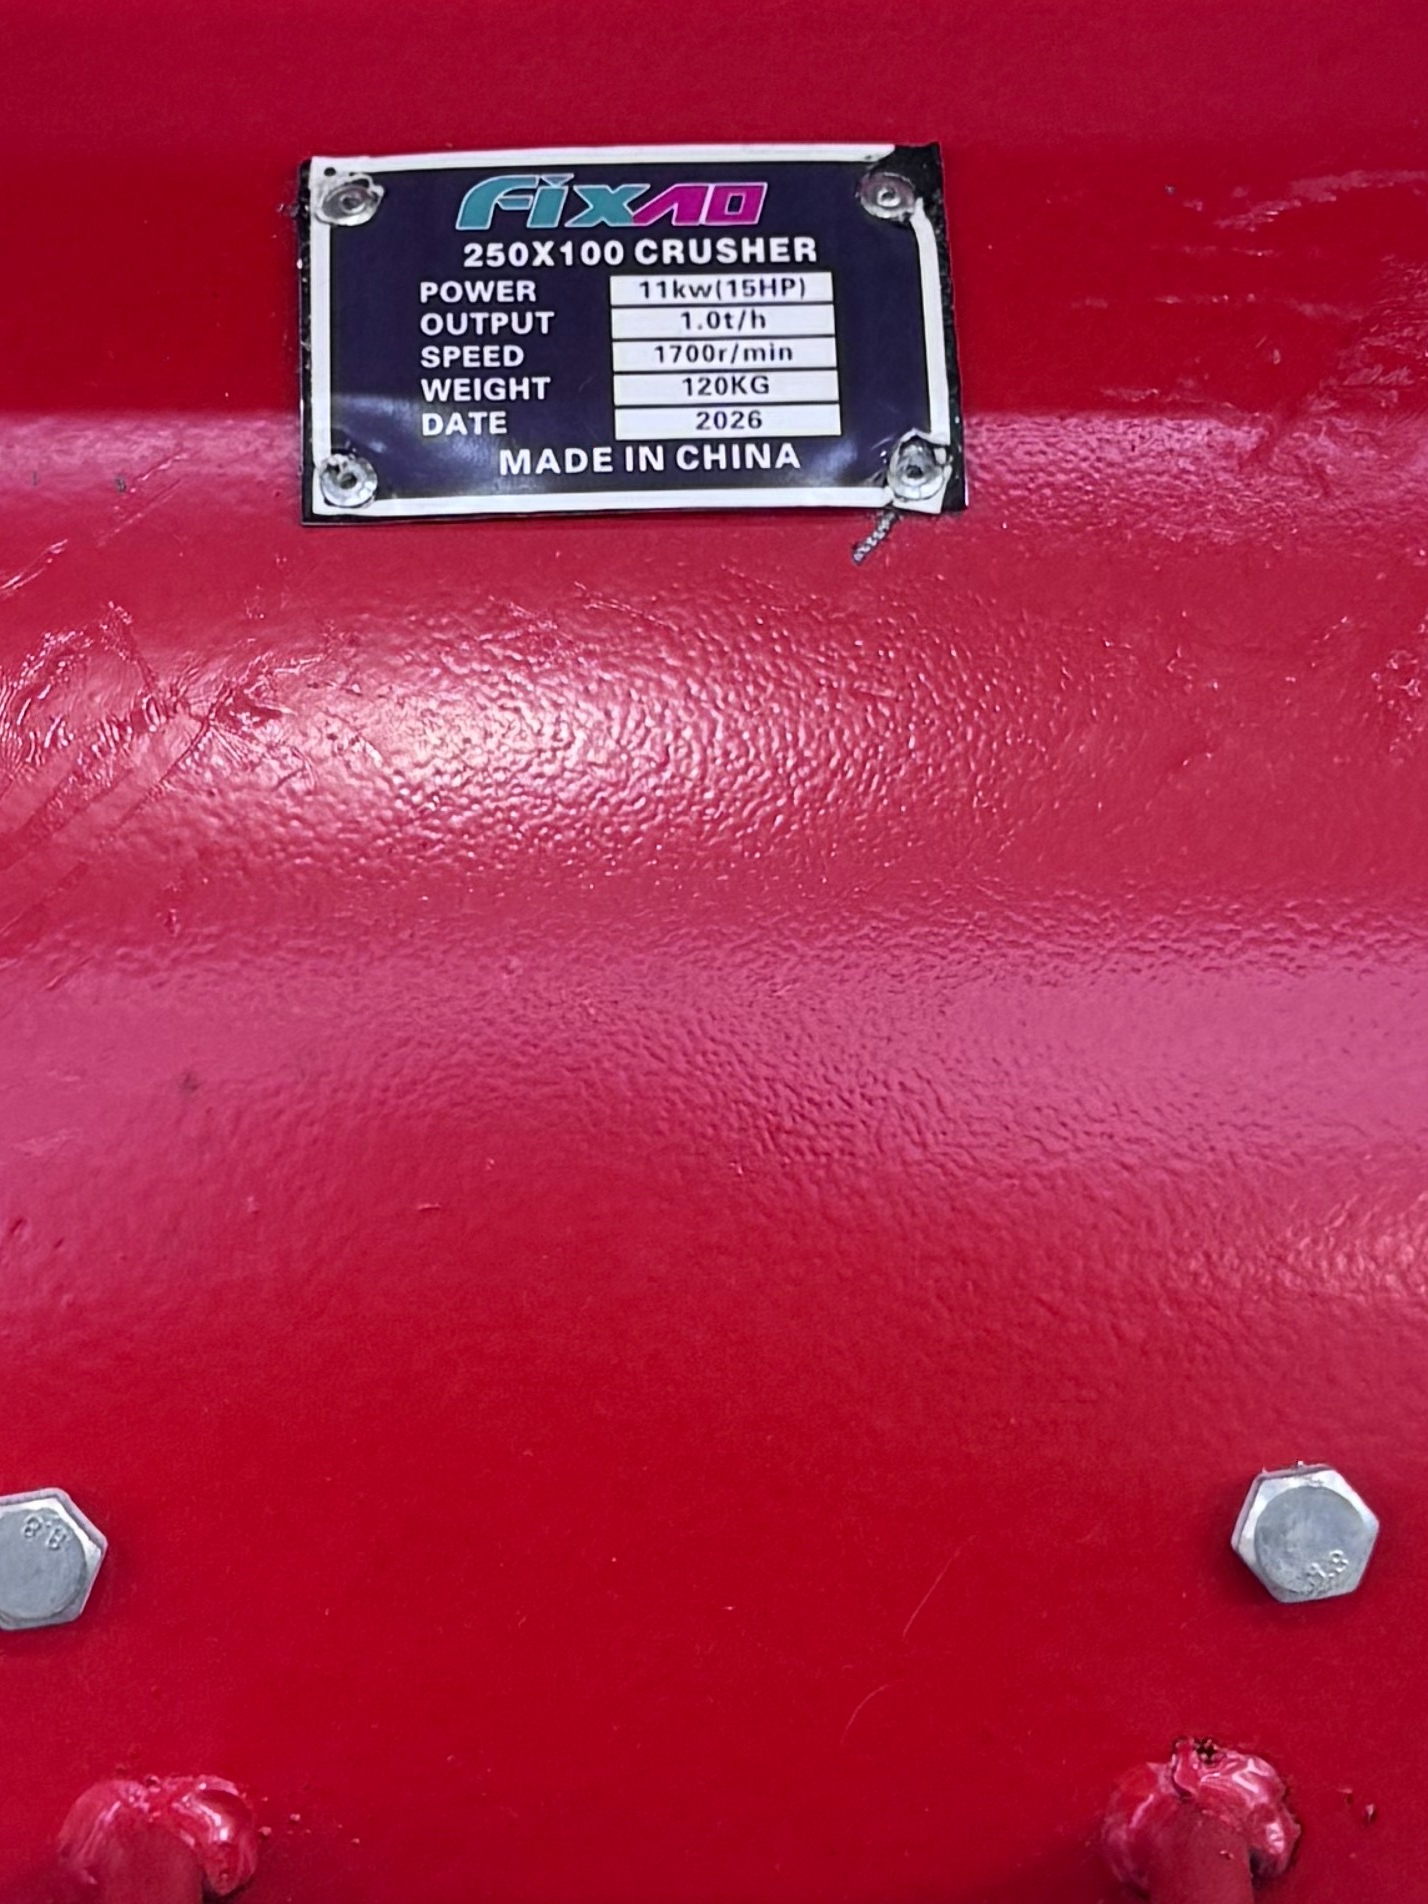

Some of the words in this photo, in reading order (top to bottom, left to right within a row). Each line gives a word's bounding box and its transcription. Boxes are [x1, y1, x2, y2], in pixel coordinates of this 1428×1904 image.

[464, 240, 624, 268] 250X100
[634, 238, 817, 264] CRUSHER
[420, 281, 536, 303] POWER
[639, 277, 806, 302] 11kw(15HP)
[421, 312, 554, 336] OUTPUT
[682, 310, 766, 331] 1.0t/h
[421, 345, 525, 368] SPEED
[654, 343, 793, 364] 1700r/min
[422, 377, 551, 400] WEIGHT
[683, 375, 770, 397] 120KG
[422, 411, 507, 436] DATE
[696, 410, 762, 431] 2026
[499, 447, 612, 476] MADE
[625, 446, 664, 471] IN
[676, 442, 801, 471] CHINA
